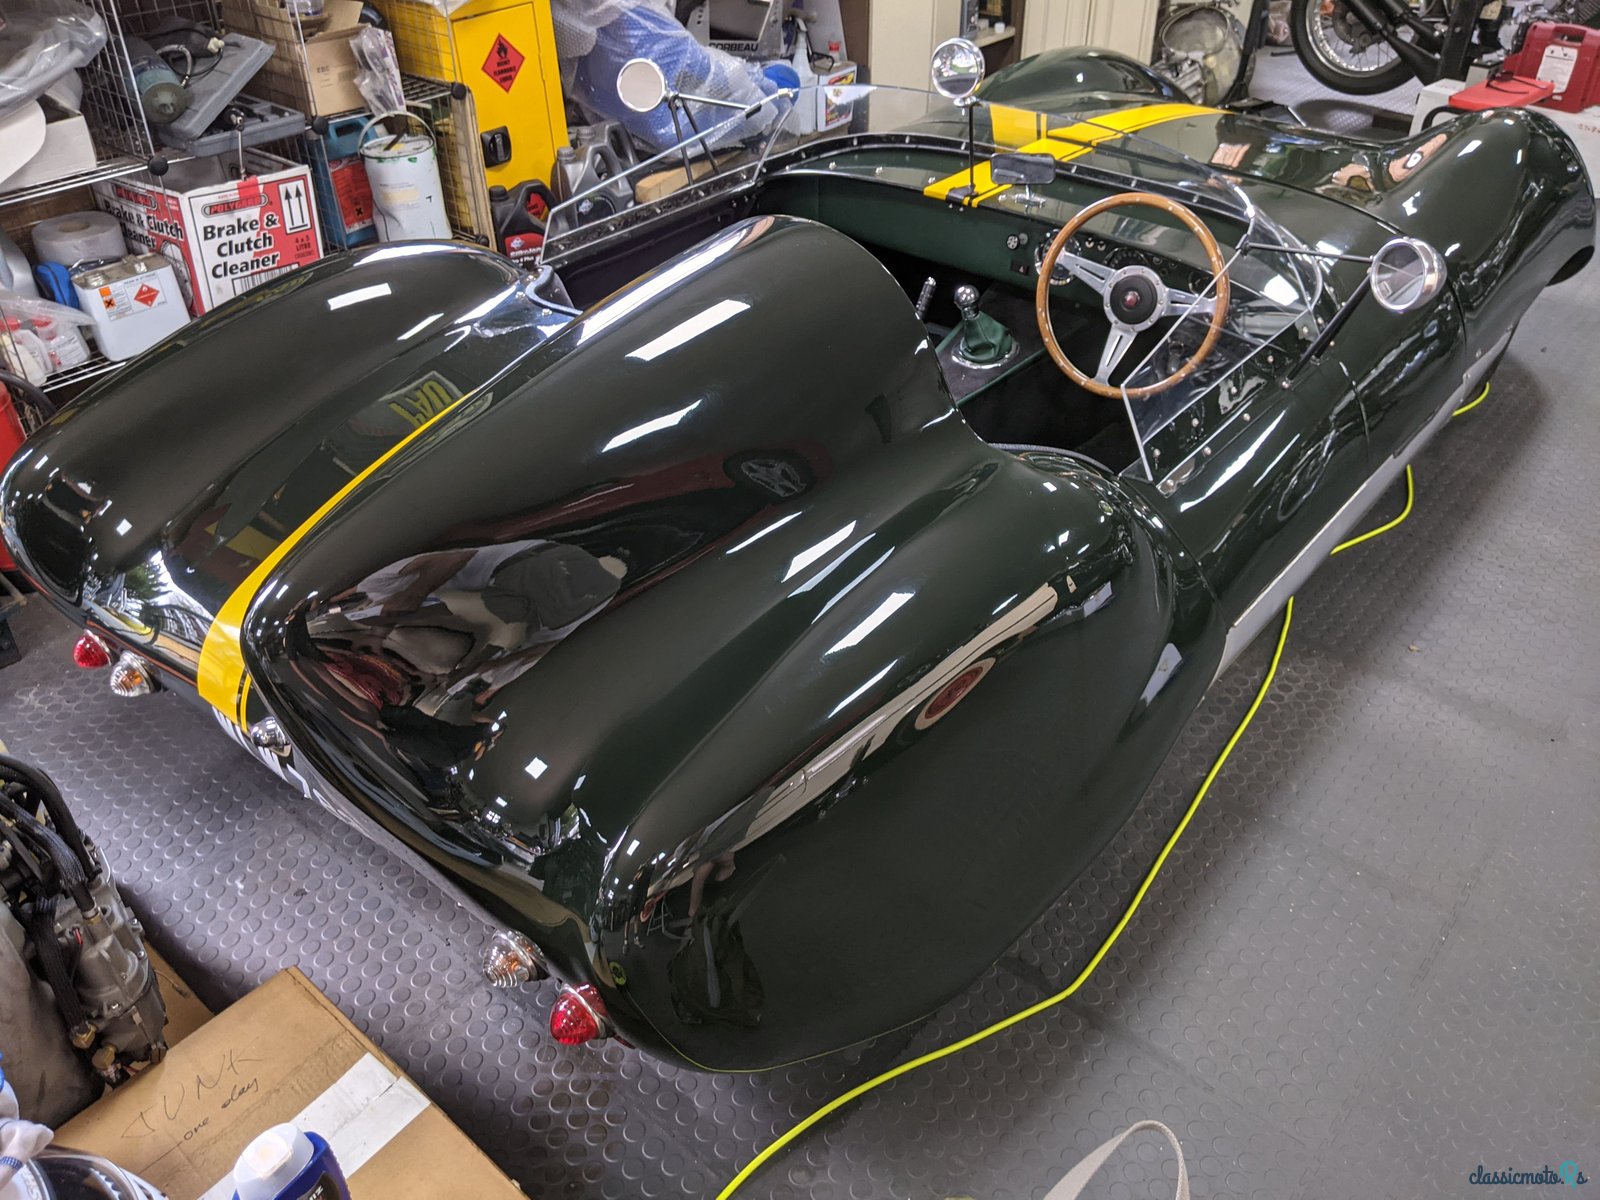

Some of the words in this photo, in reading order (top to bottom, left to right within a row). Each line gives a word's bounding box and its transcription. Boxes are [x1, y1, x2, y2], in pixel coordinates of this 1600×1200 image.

[120, 222, 155, 248] leaner
[147, 215, 184, 240] Clutch
[203, 218, 259, 241] Brake
[265, 214, 278, 227] &
[217, 232, 273, 257] Clutch
[212, 253, 279, 279] Cleaner
[184, 1117, 209, 1141] one
[221, 1078, 258, 1109] day
